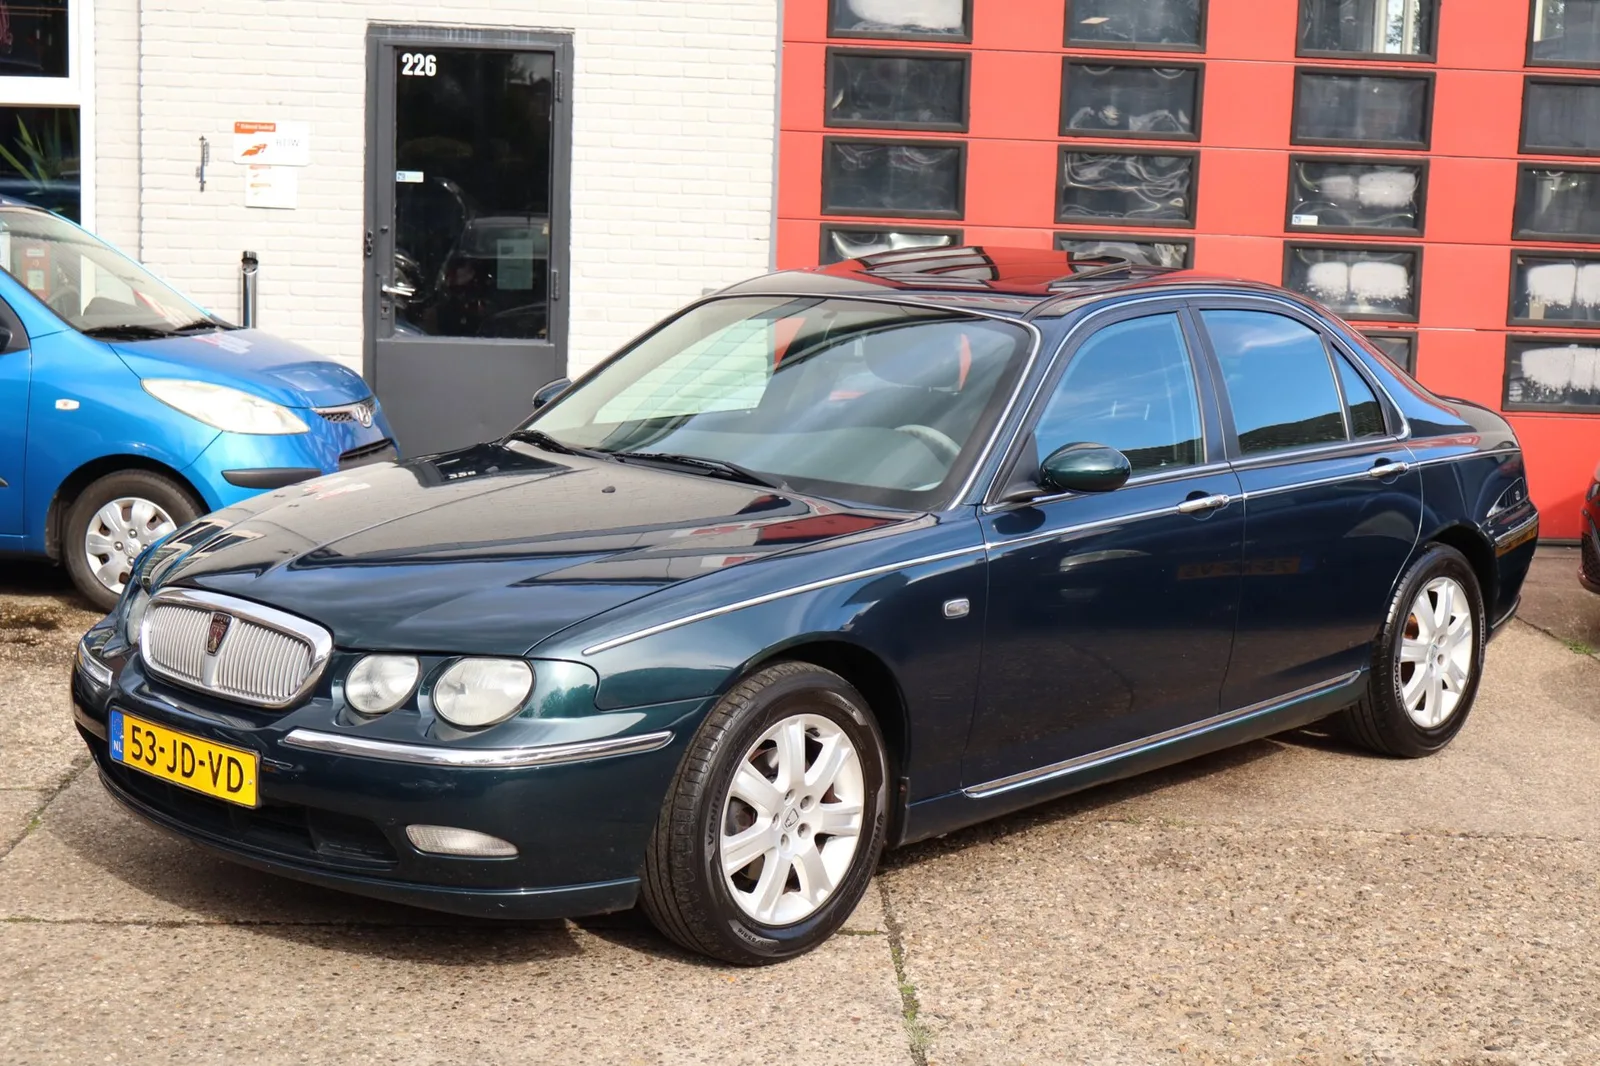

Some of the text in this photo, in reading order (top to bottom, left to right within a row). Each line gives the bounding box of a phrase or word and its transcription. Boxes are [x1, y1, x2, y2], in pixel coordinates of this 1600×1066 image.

[402, 53, 437, 77] 226
[113, 740, 123, 753] NL
[131, 724, 244, 793] 53-JD-VD
